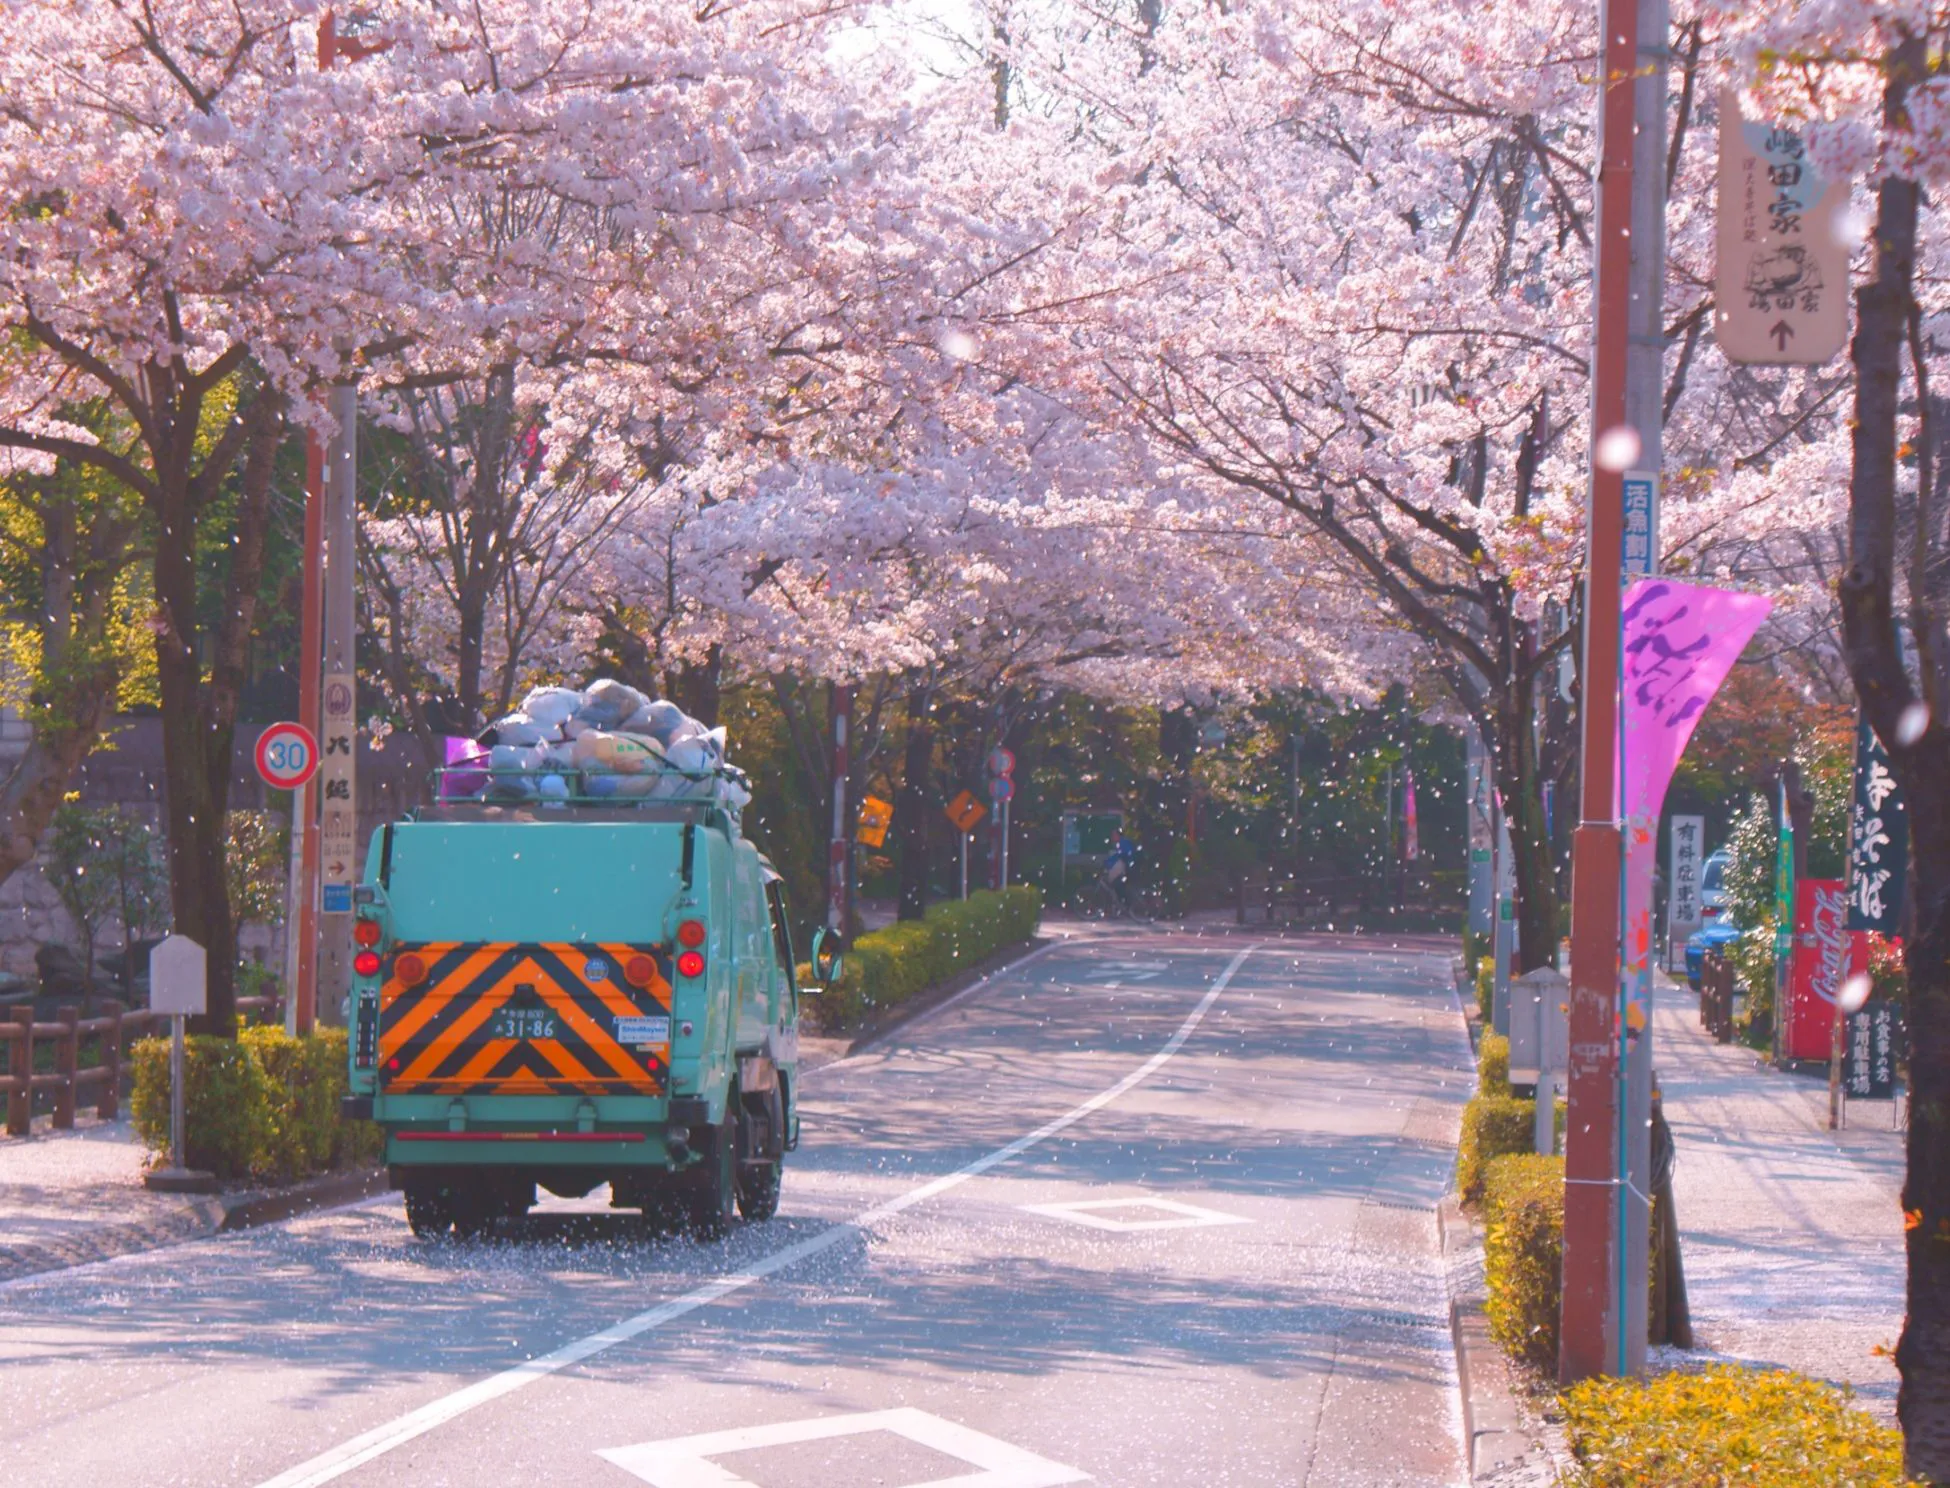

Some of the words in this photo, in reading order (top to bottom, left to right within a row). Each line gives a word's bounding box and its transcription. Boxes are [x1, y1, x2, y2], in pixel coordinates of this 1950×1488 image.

[269, 741, 306, 771] 30
[1676, 821, 1697, 922] 有料駐車場
[505, 1019, 554, 1037] 31-86
[1852, 1011, 1871, 1094] 専用駐車場
[1875, 1009, 1891, 1083] お食事の方
